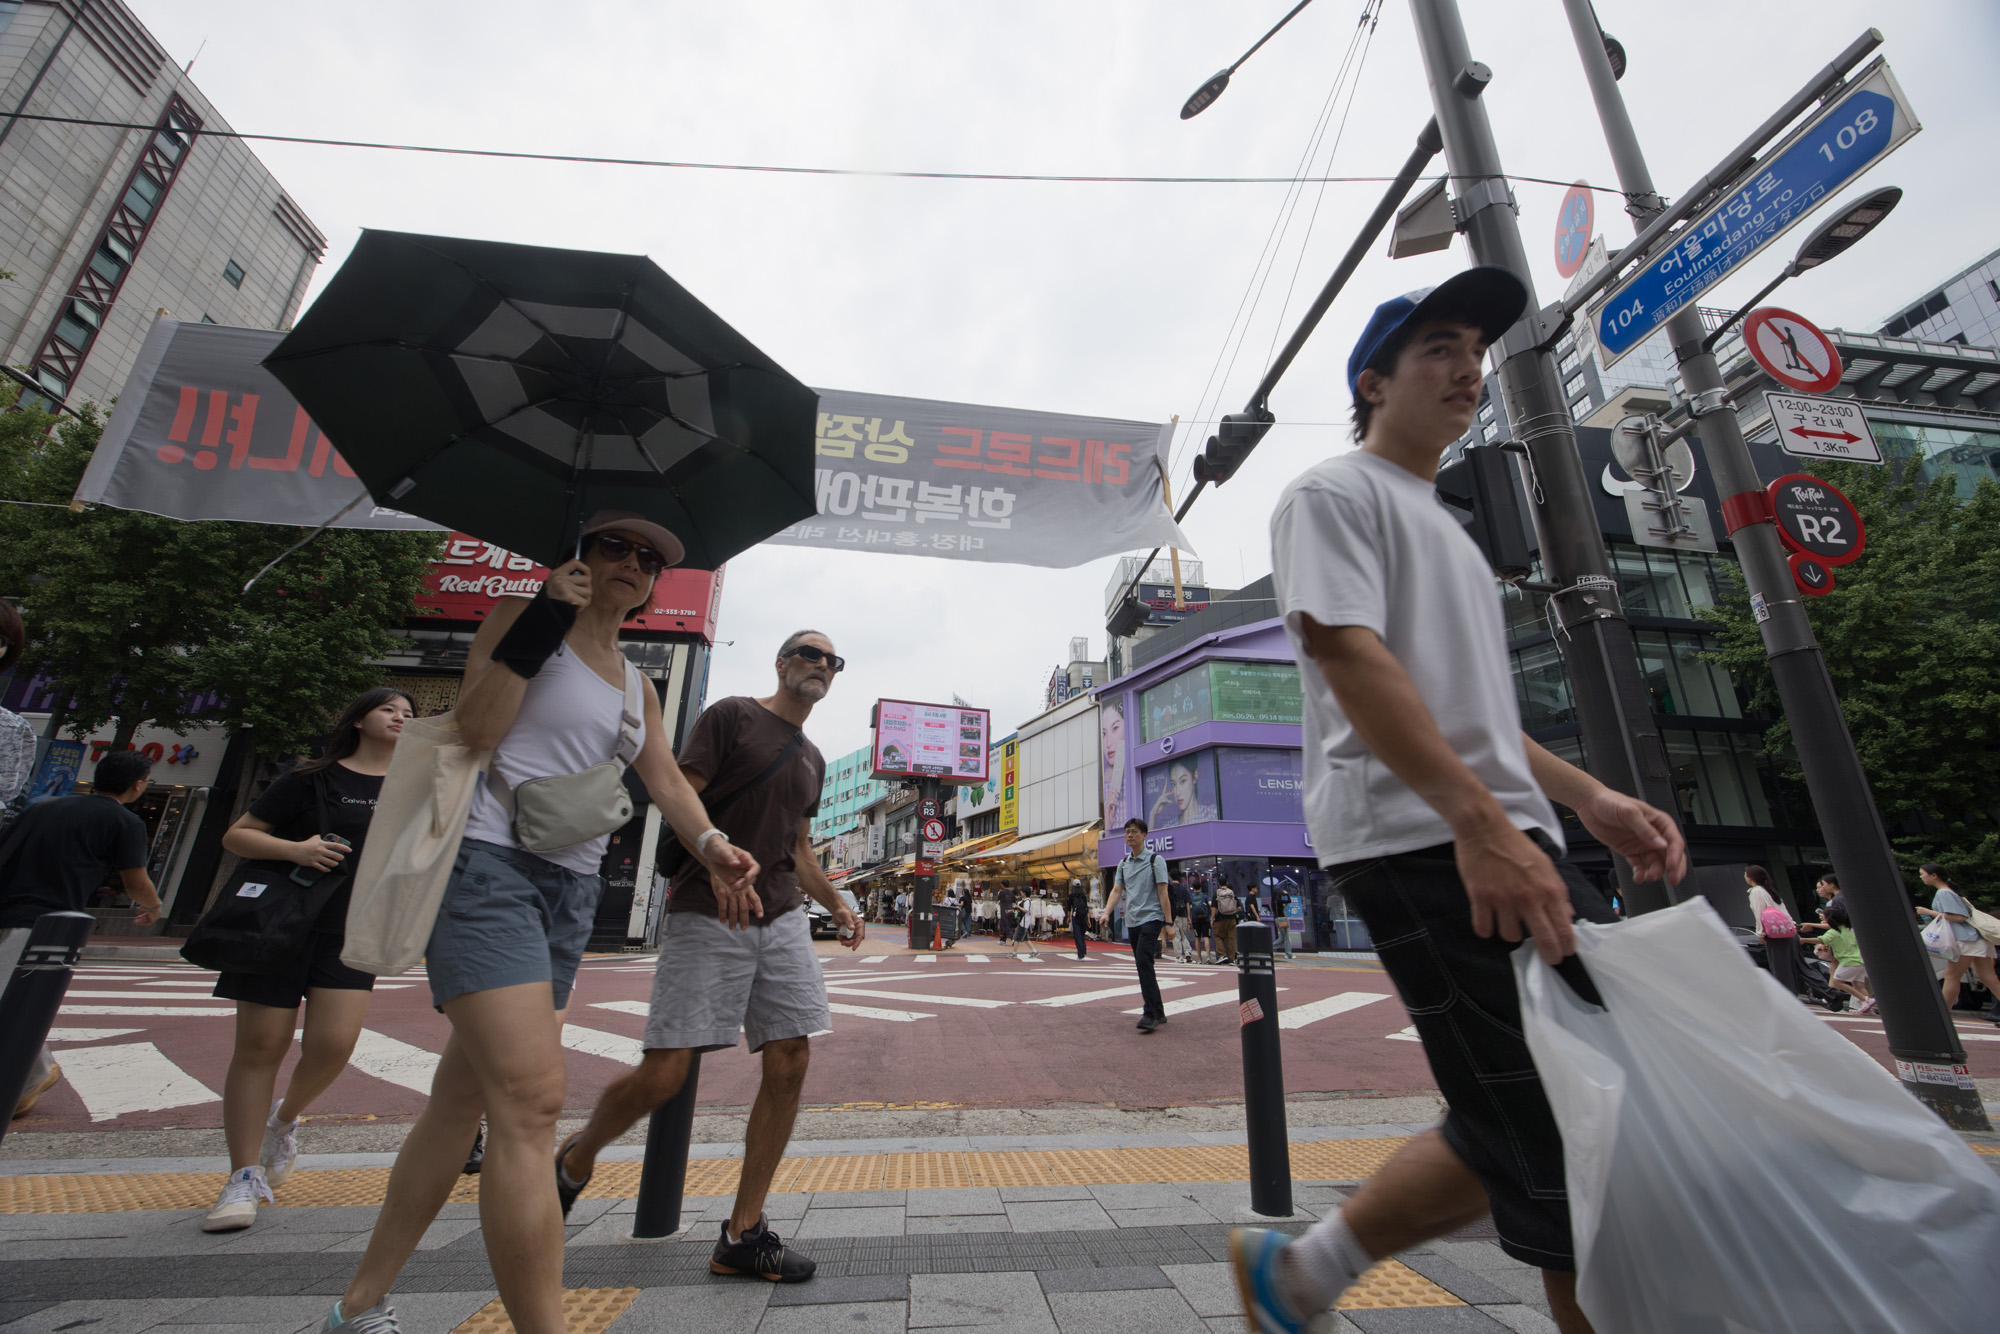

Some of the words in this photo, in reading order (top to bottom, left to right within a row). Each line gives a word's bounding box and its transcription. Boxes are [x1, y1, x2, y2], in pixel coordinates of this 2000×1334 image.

[1818, 108, 1879, 163] 108
[1659, 171, 1783, 275] 어울마당로
[1664, 188, 1793, 296] Eoulmadang-ro
[1608, 298, 1645, 336] 104
[1777, 399, 1854, 418] 12:00~23:00
[1813, 441, 1850, 454] 1.3Km
[1796, 514, 1848, 544] R2
[484, 575, 545, 598] Butto
[1258, 778, 1306, 790] LENSM
[341, 796, 367, 805] Calvin
[923, 808, 935, 816] R3
